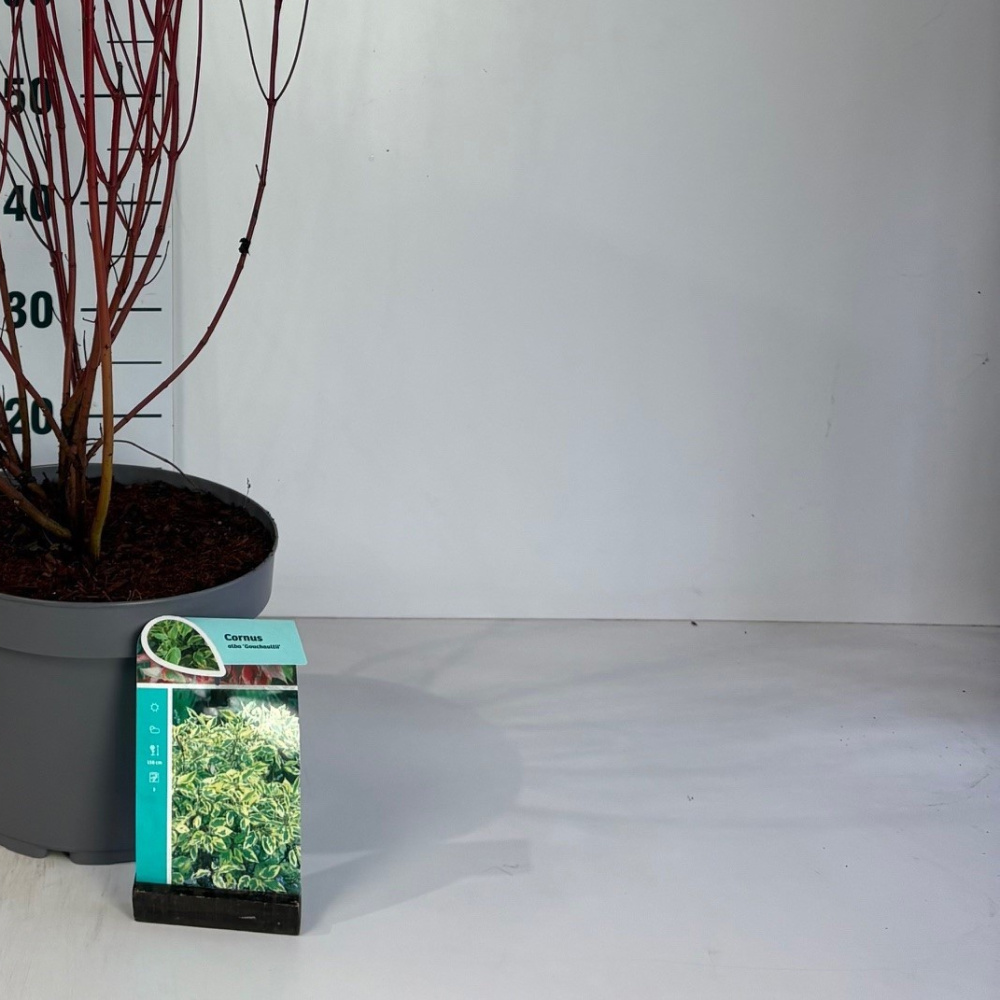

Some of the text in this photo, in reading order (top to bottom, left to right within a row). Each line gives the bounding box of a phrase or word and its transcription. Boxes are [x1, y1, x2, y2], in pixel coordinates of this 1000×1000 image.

[4, 77, 52, 115] 50
[3, 184, 53, 221] 40
[8, 291, 53, 328] 30
[4, 397, 53, 434] 20
[224, 633, 263, 642] Cornus
